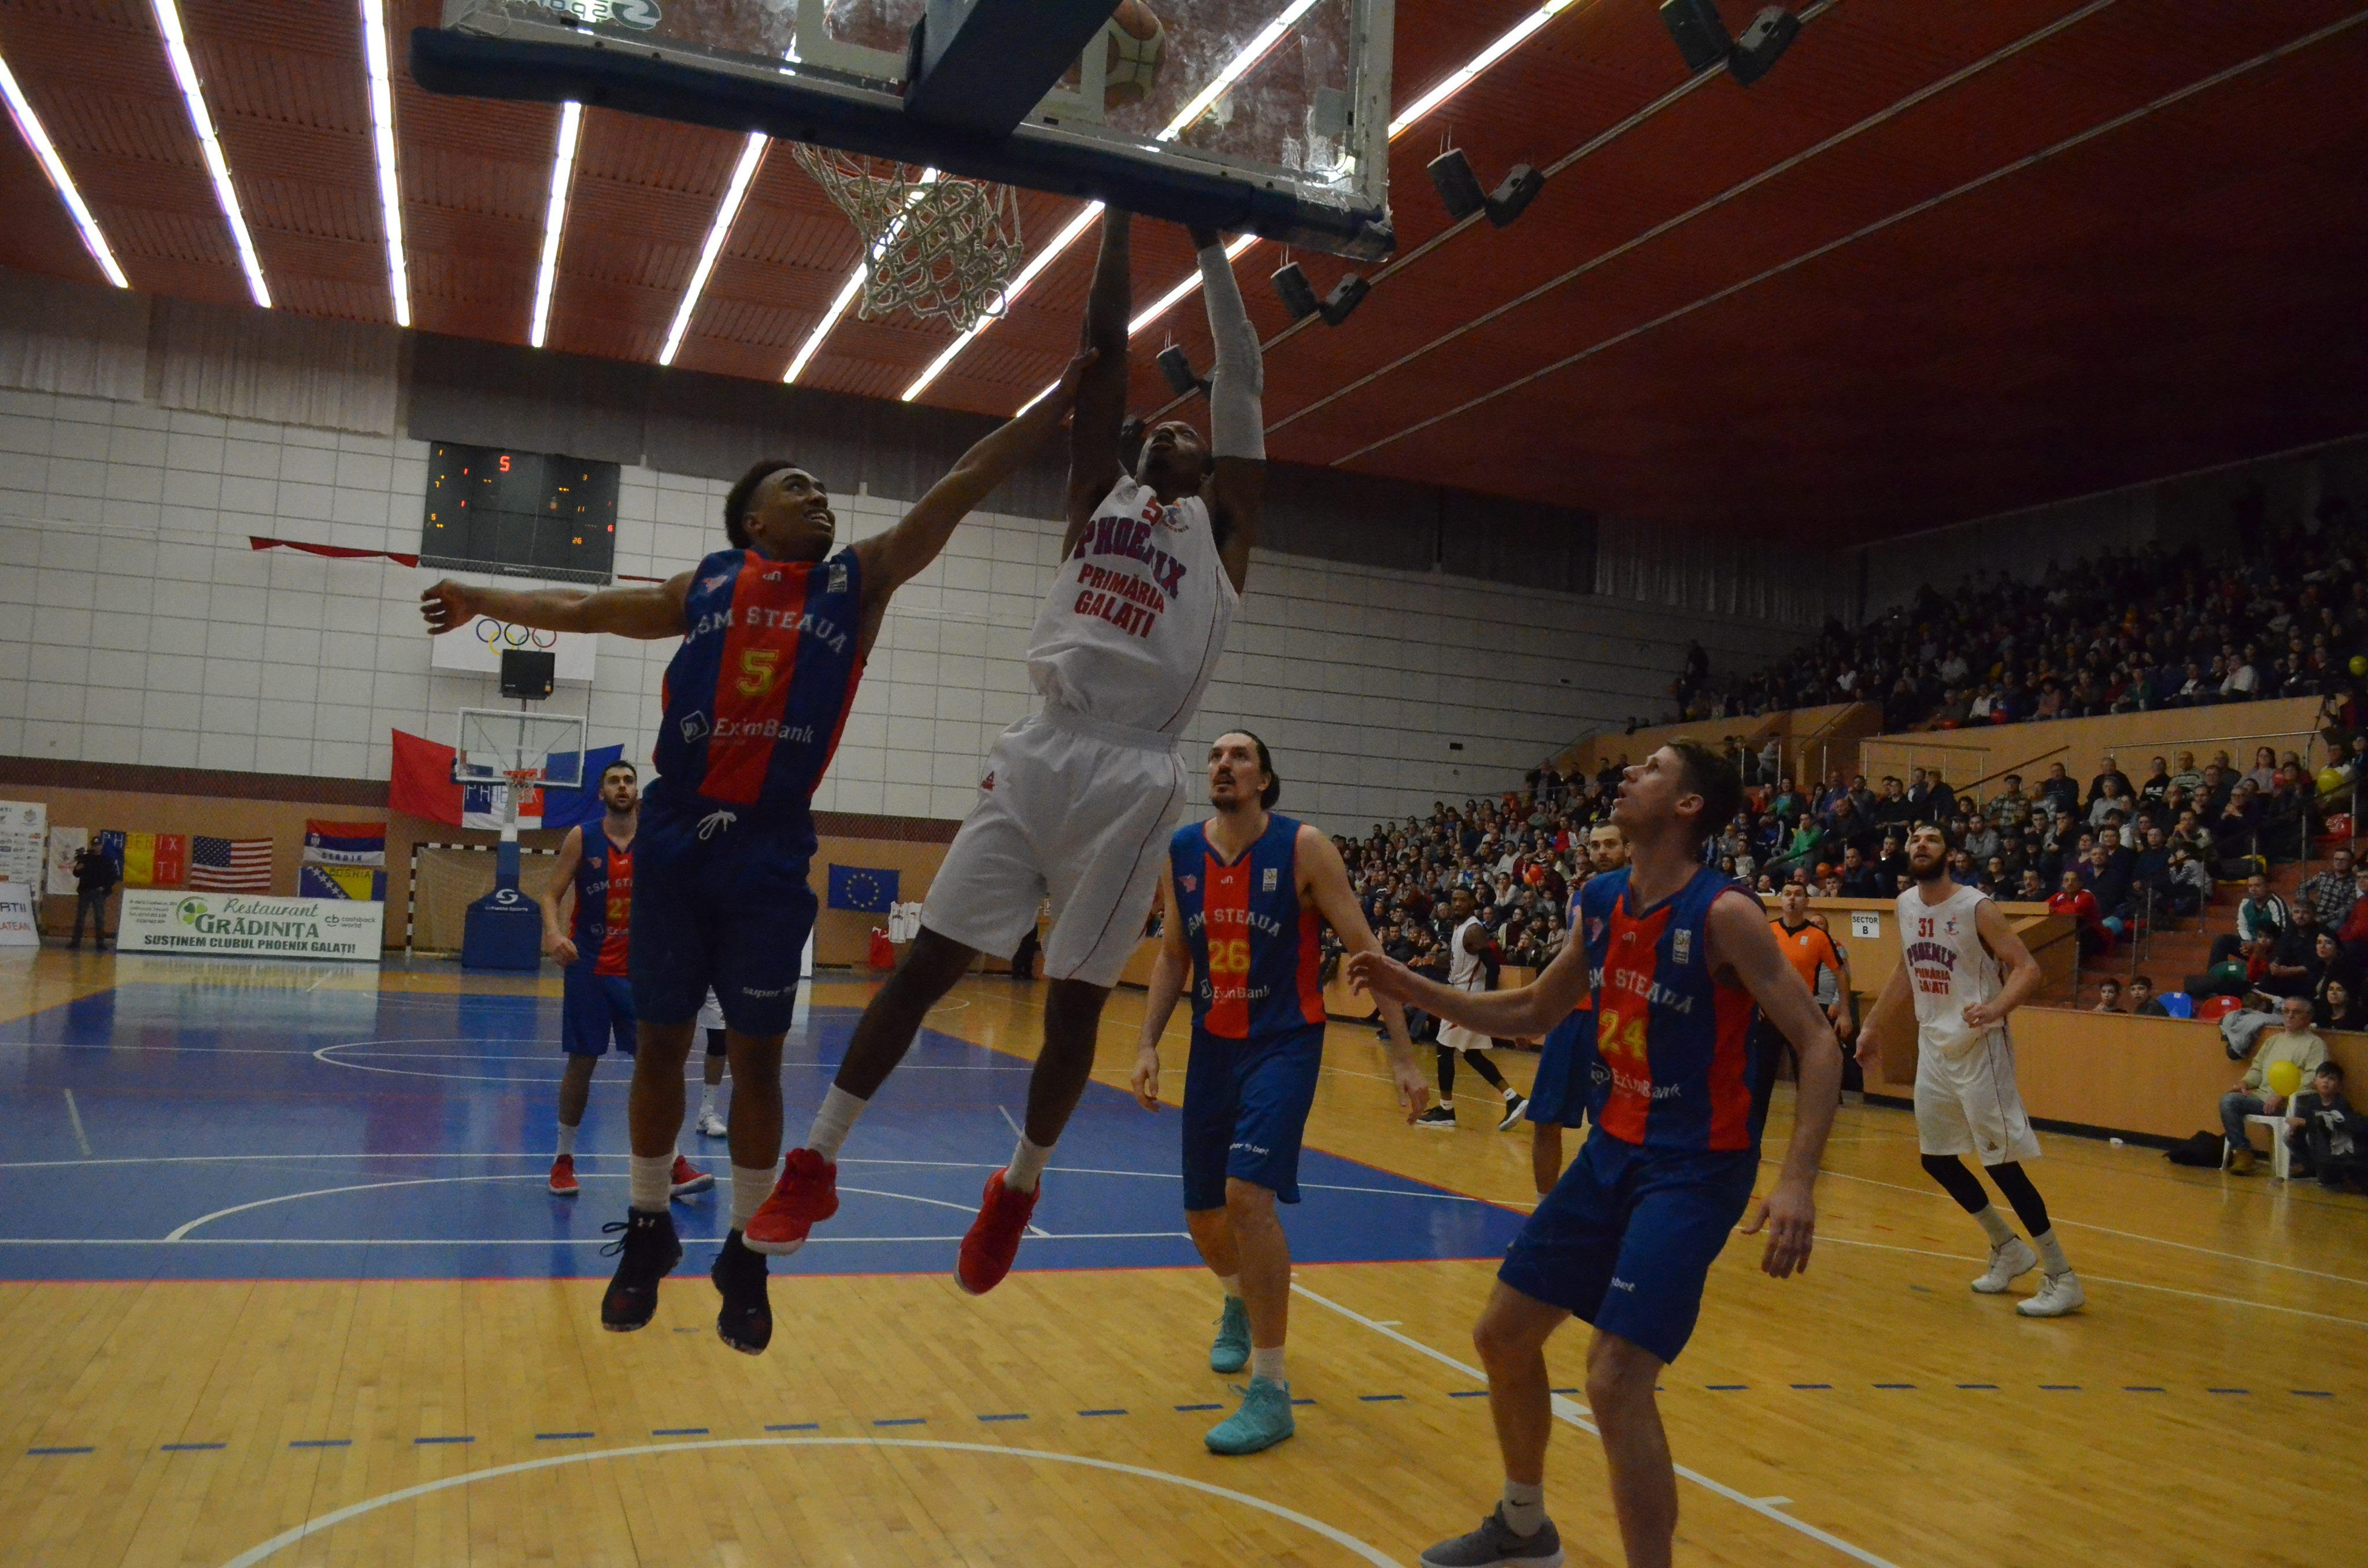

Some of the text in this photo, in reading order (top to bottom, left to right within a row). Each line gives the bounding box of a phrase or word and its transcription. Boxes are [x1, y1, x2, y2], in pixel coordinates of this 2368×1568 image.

[1074, 590, 1155, 639] GALATI
[746, 606, 848, 654] STEAUA
[738, 648, 779, 695] 5
[713, 718, 814, 744] EximBank
[586, 879, 610, 896] CSM
[223, 897, 319, 917] Restaurant
[1214, 908, 1282, 938] STEAUA
[1863, 926, 1868, 934] B
[1918, 918, 1934, 937] 31
[209, 937, 255, 949] CLUBUL
[258, 940, 308, 951] PHOENIX
[1208, 938, 1251, 973] 26
[1907, 942, 1957, 972] PHOENIX
[1615, 967, 1695, 1014] STEAUA
[1597, 1008, 1649, 1062] 24
